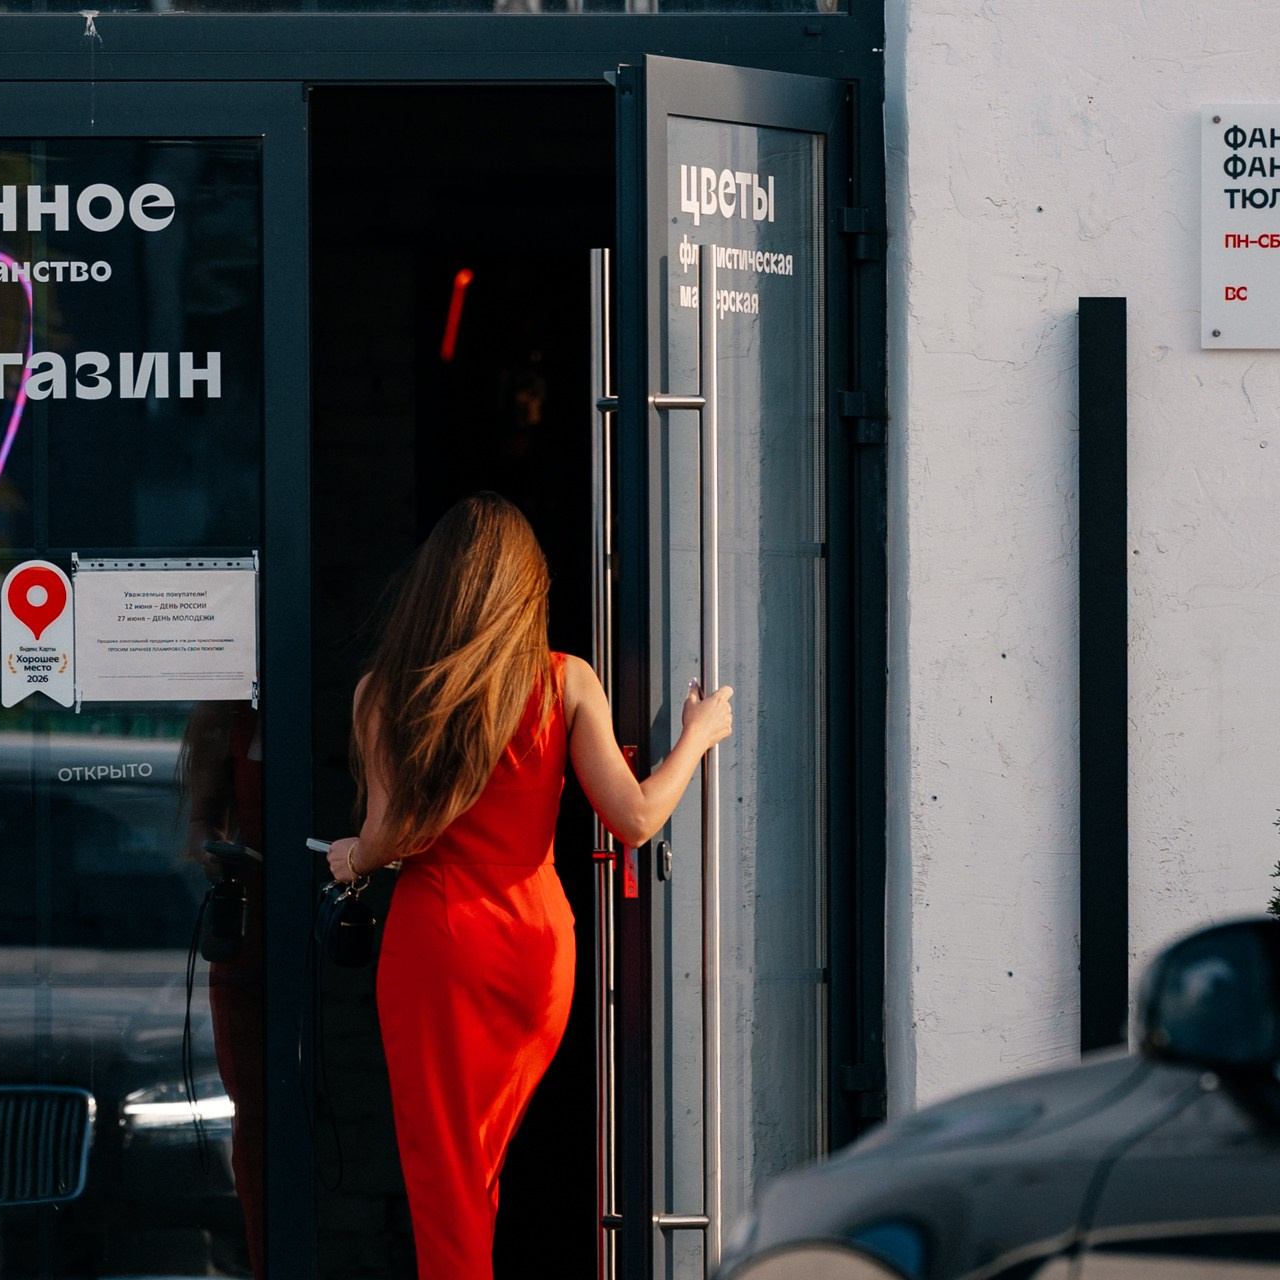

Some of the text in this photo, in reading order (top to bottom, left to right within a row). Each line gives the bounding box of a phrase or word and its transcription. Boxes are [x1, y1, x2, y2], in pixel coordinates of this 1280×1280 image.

[680, 164, 775, 226] цветы
[680, 234, 793, 276] флистическая
[1225, 286, 1248, 300] ВС
[16, 655, 60, 664] Хорошее
[58, 763, 152, 782] ОТКРЫТО
